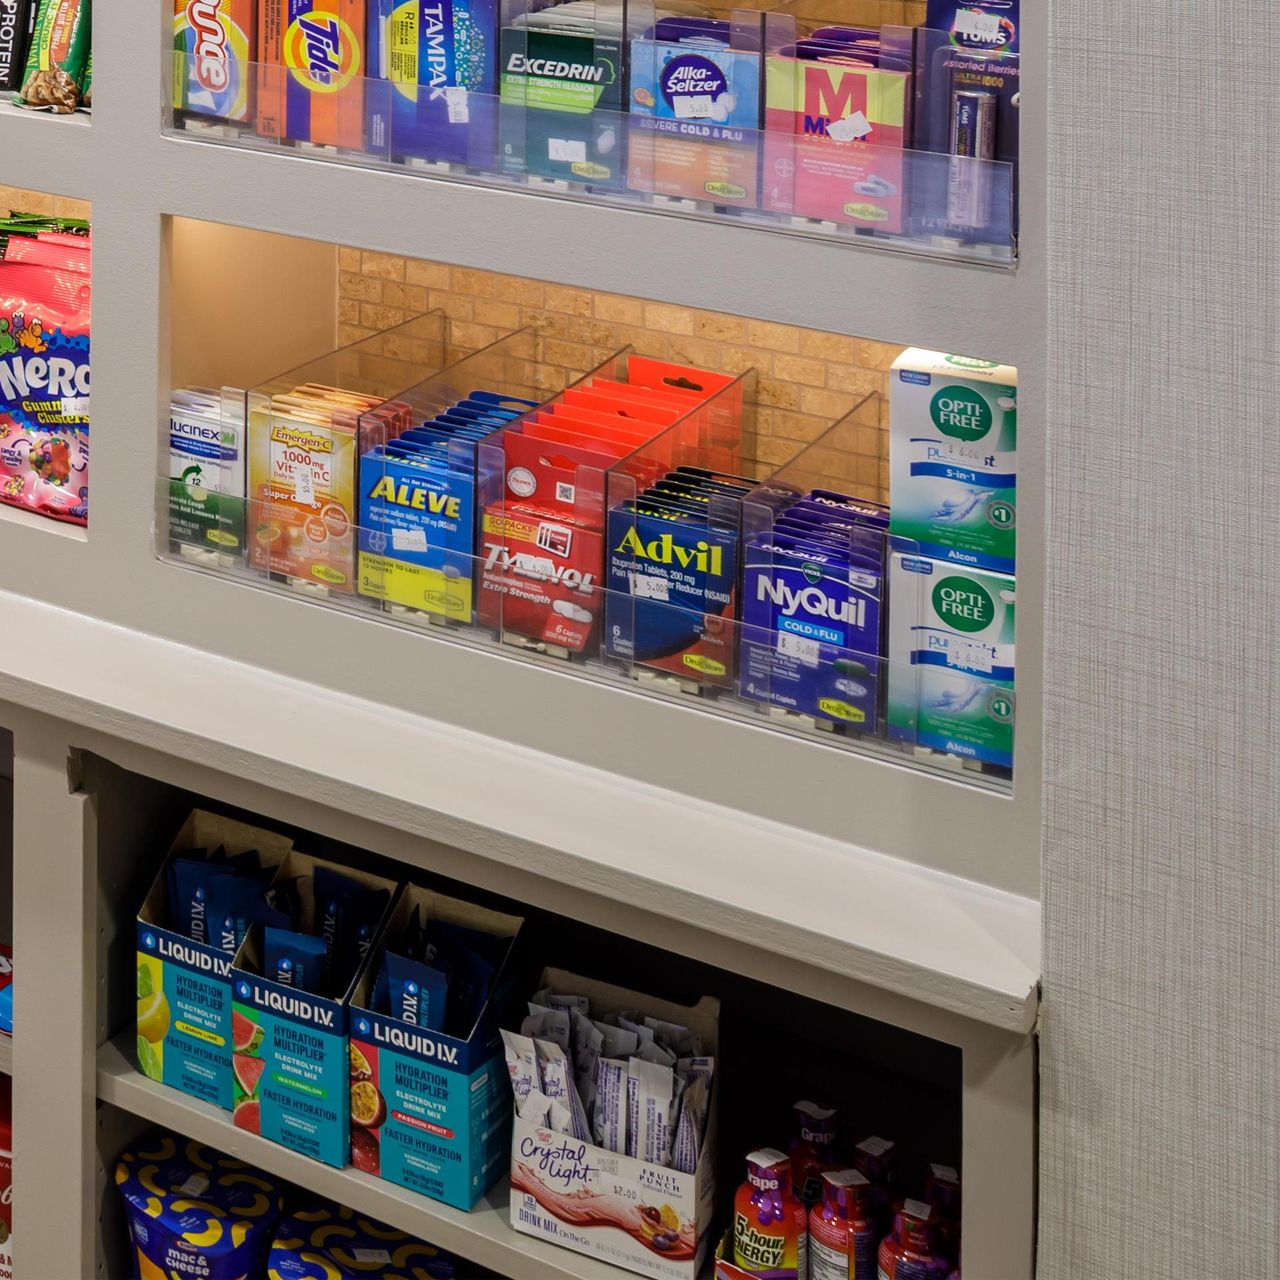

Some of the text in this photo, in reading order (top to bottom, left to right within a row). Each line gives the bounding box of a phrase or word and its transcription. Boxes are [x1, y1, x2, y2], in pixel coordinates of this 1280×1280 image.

[297, 16, 339, 85] Tide
[424, 3, 448, 101] TAMPAX
[507, 54, 602, 81] EXCEDRIN
[669, 67, 712, 80] Alka-
[667, 78, 720, 92] Seltzer
[804, 66, 867, 120] M
[690, 103, 708, 113] 5.00
[641, 120, 678, 132] SEVERE
[681, 124, 710, 136] COLD
[722, 129, 742, 140] FLU
[939, 399, 982, 416] OPTI-
[940, 413, 981, 428] FREE
[276, 430, 330, 448] Emergen-C
[959, 447, 980, 458] 6.00
[312, 461, 324, 470] mg
[946, 469, 976, 481] 5-in-1
[263, 488, 289, 500] Super
[371, 477, 461, 518] ALEVE
[614, 526, 722, 576] Advil
[949, 550, 977, 563] Alcon
[643, 564, 695, 586] Tablets, 200 mg
[483, 582, 550, 604] Extra Strength
[757, 576, 865, 627] NyQuil
[785, 622, 837, 641] COLD FLU
[159, 939, 232, 977] LIQUID I.V.
[374, 1023, 458, 1065] LIQUID I.V.
[395, 1061, 448, 1088] HYDRATION
[395, 1077, 449, 1100] MULTIPLIER
[396, 1090, 447, 1112] ELECTROLYTE
[398, 1113, 447, 1134] PASSION FRUIT
[521, 1138, 586, 1168] Crystal
[549, 1163, 592, 1190] Light
[640, 1174, 680, 1192] PUNCH
[643, 1169, 677, 1184] FRUIT
[614, 1185, 636, 1200] $2.00
[519, 1211, 557, 1234] DRINK MIX
[736, 1216, 784, 1249] 5-hour
[168, 1248, 207, 1266] mac &
